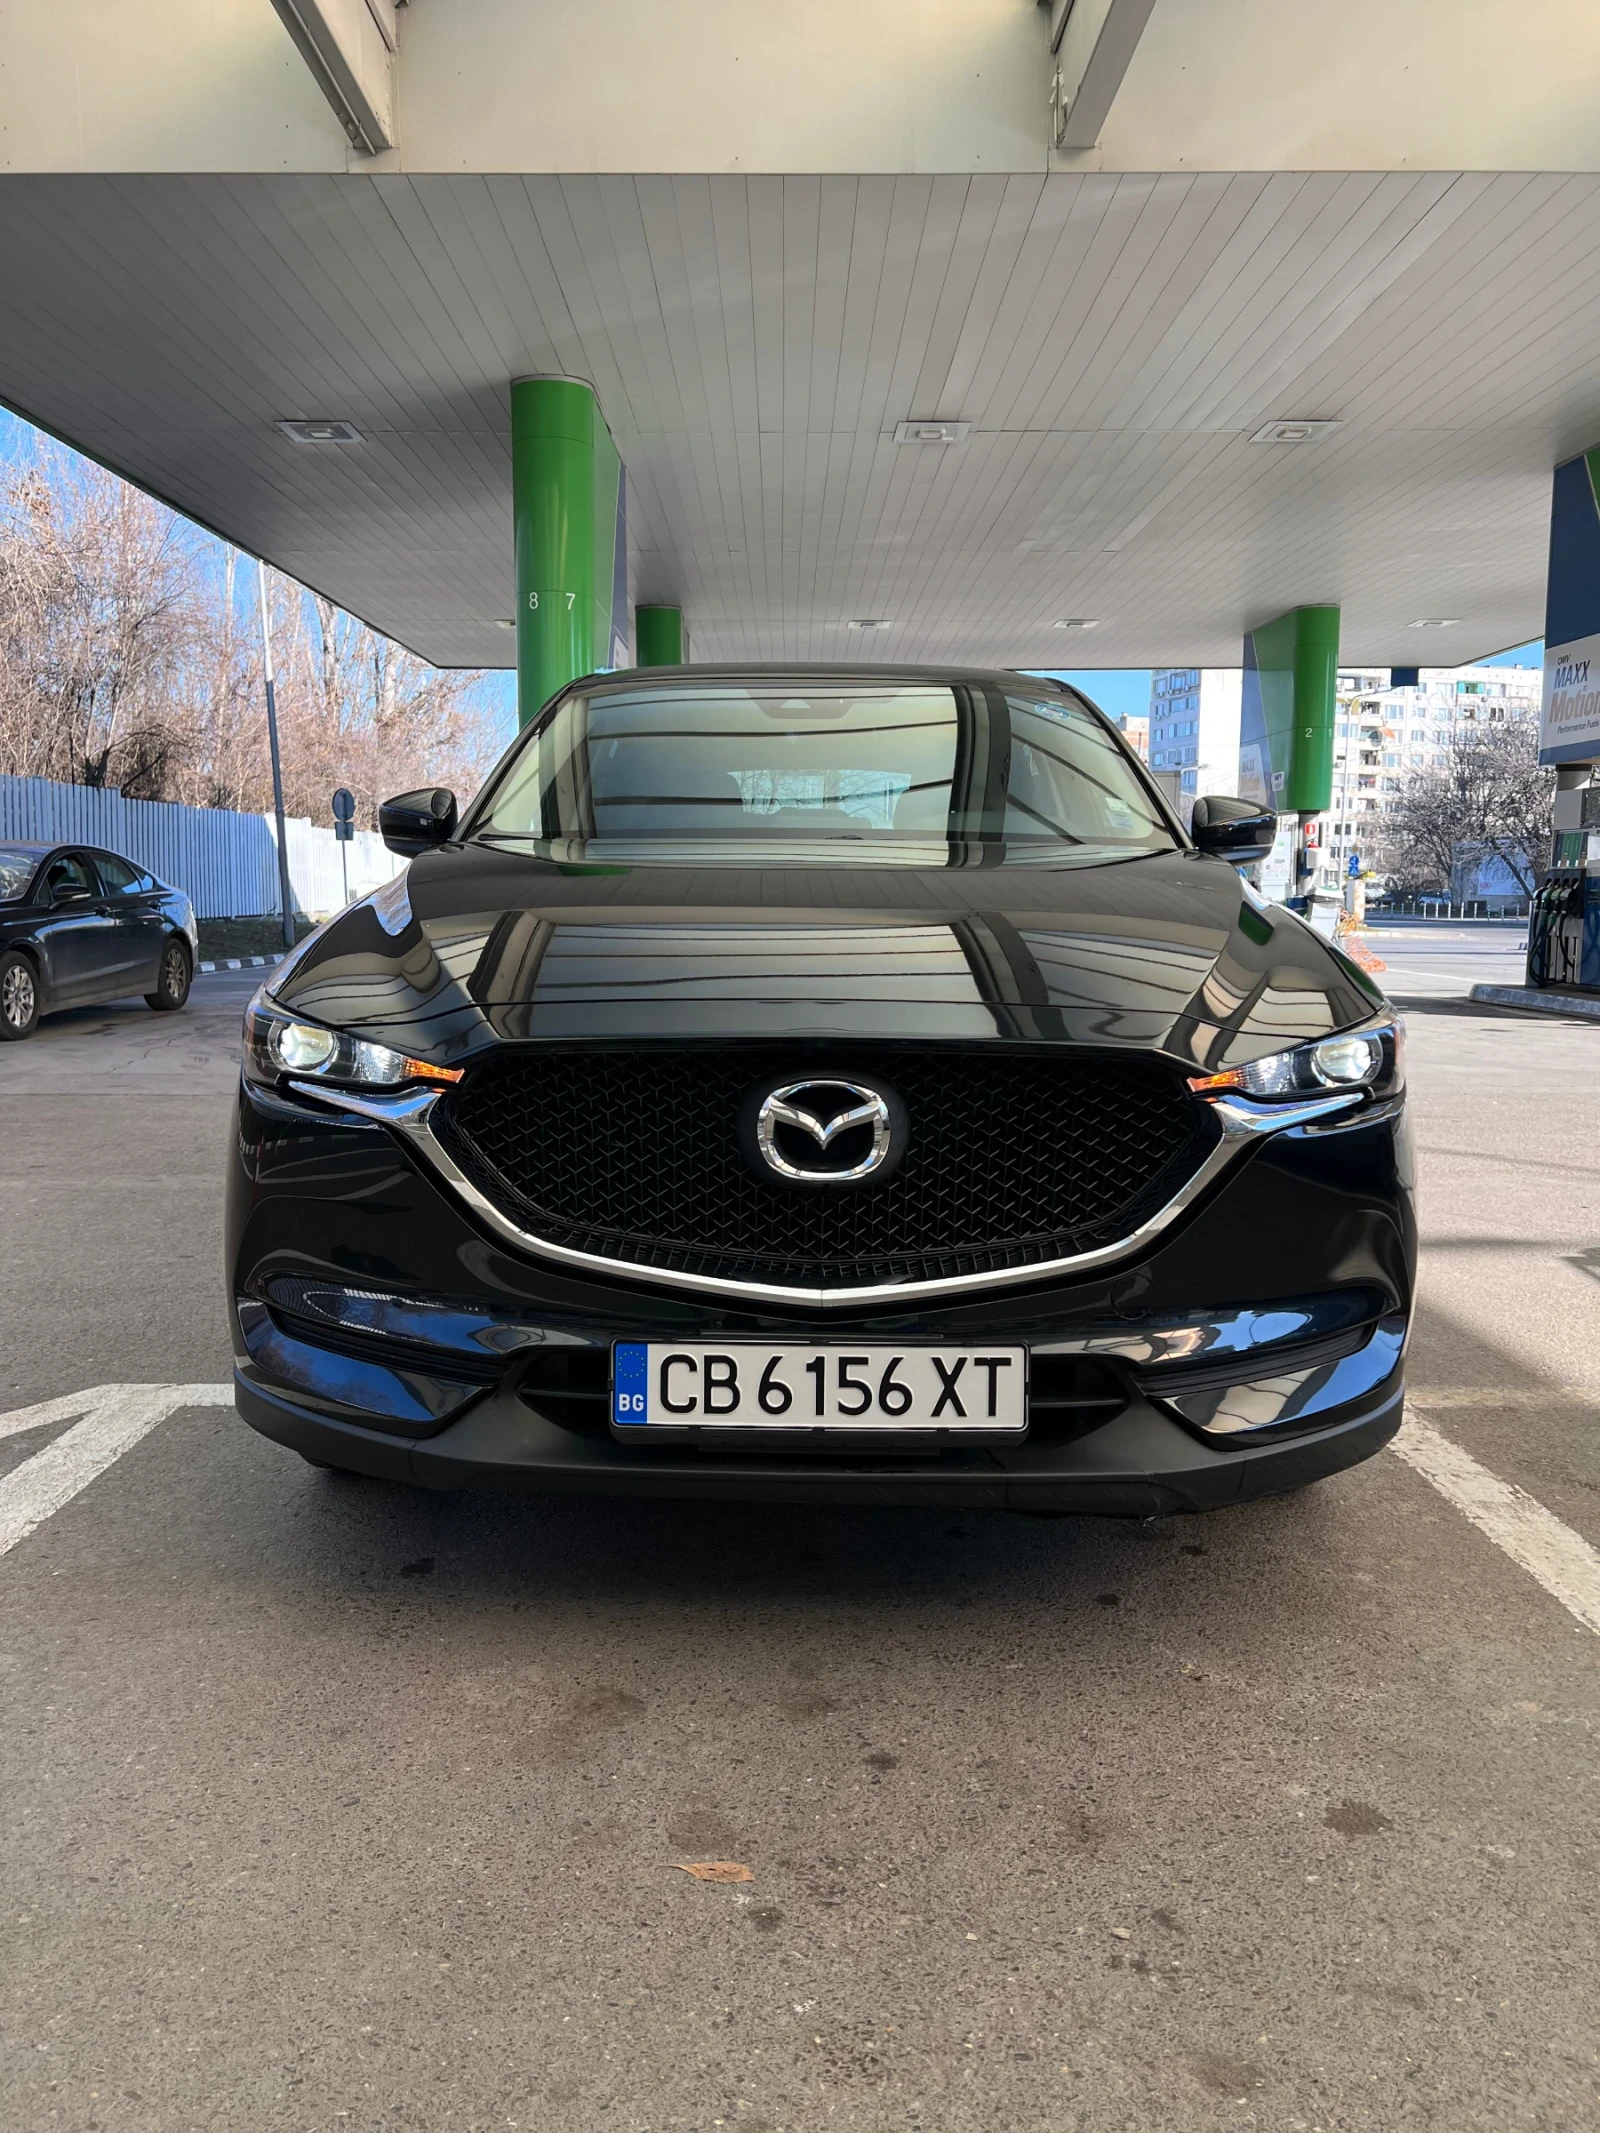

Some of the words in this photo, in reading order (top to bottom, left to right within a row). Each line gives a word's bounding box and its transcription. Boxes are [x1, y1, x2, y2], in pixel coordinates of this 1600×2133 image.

[529, 591, 539, 610] 8
[565, 592, 576, 611] 7
[1557, 654, 1571, 666] OMV
[1554, 660, 1591, 690] MAXX
[1549, 685, 1600, 724] Motion
[1305, 727, 1313, 738] 2
[1557, 721, 1587, 734] Performance
[1586, 719, 1600, 730] Fuels
[660, 1354, 741, 1414] CB
[758, 1355, 913, 1416] 6156
[930, 1356, 1012, 1417] XT
[618, 1393, 644, 1412] BG
